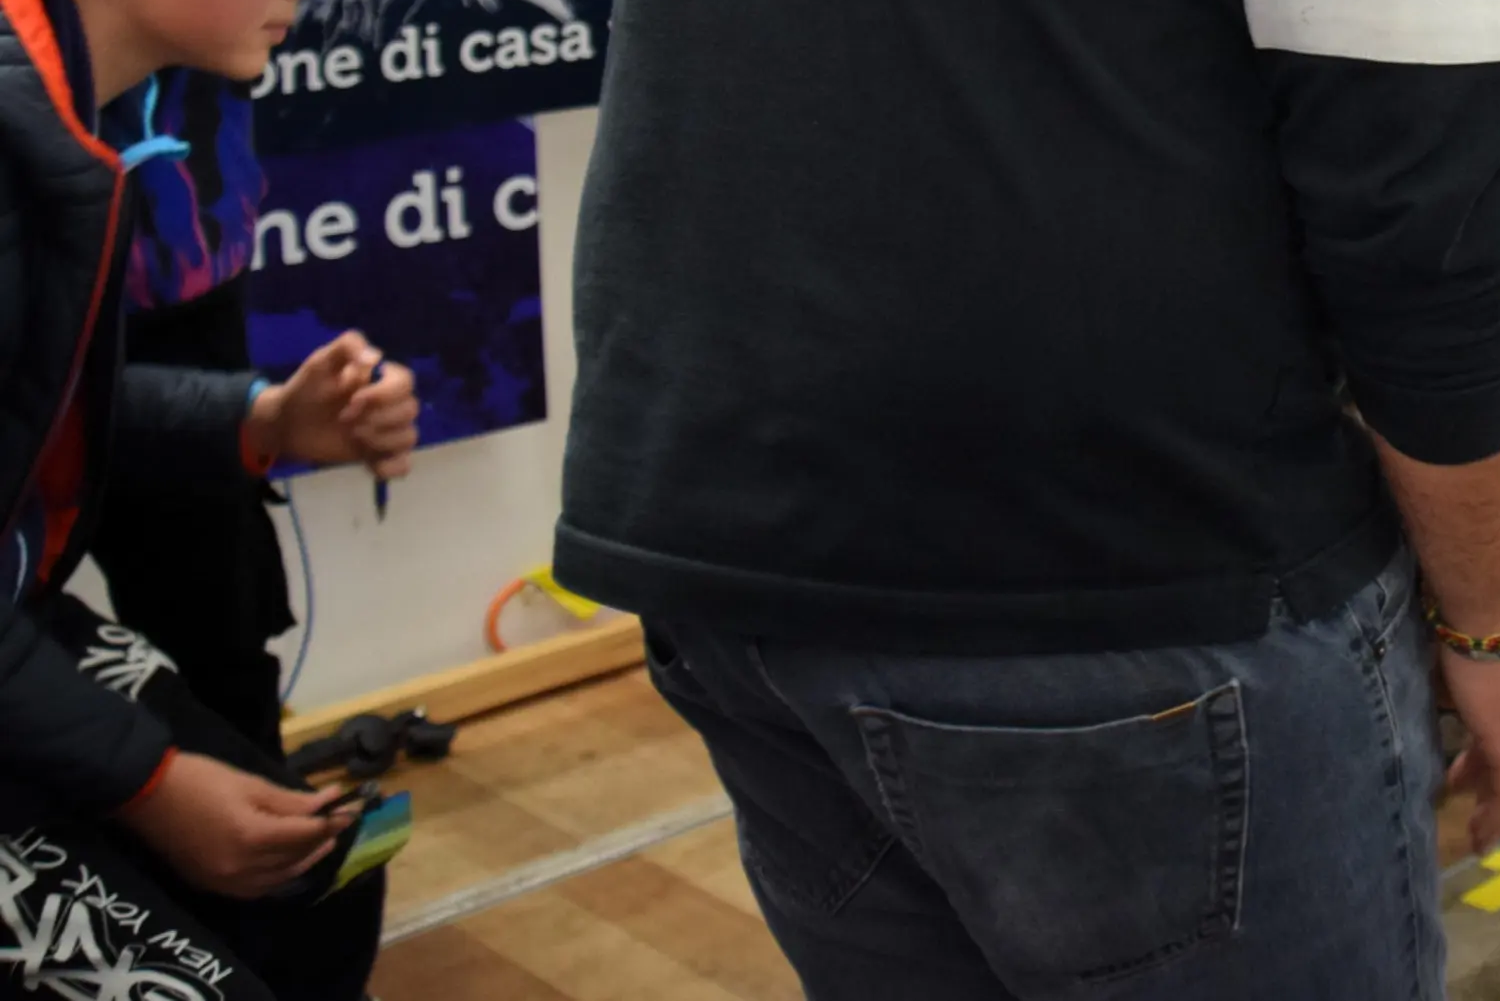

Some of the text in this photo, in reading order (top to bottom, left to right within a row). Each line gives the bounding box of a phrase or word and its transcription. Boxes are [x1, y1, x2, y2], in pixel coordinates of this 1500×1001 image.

[381, 23, 444, 82] di
[460, 20, 595, 72] casa
[384, 166, 471, 248] di
[60, 863, 151, 935] YORK
[147, 929, 233, 985] NEW
